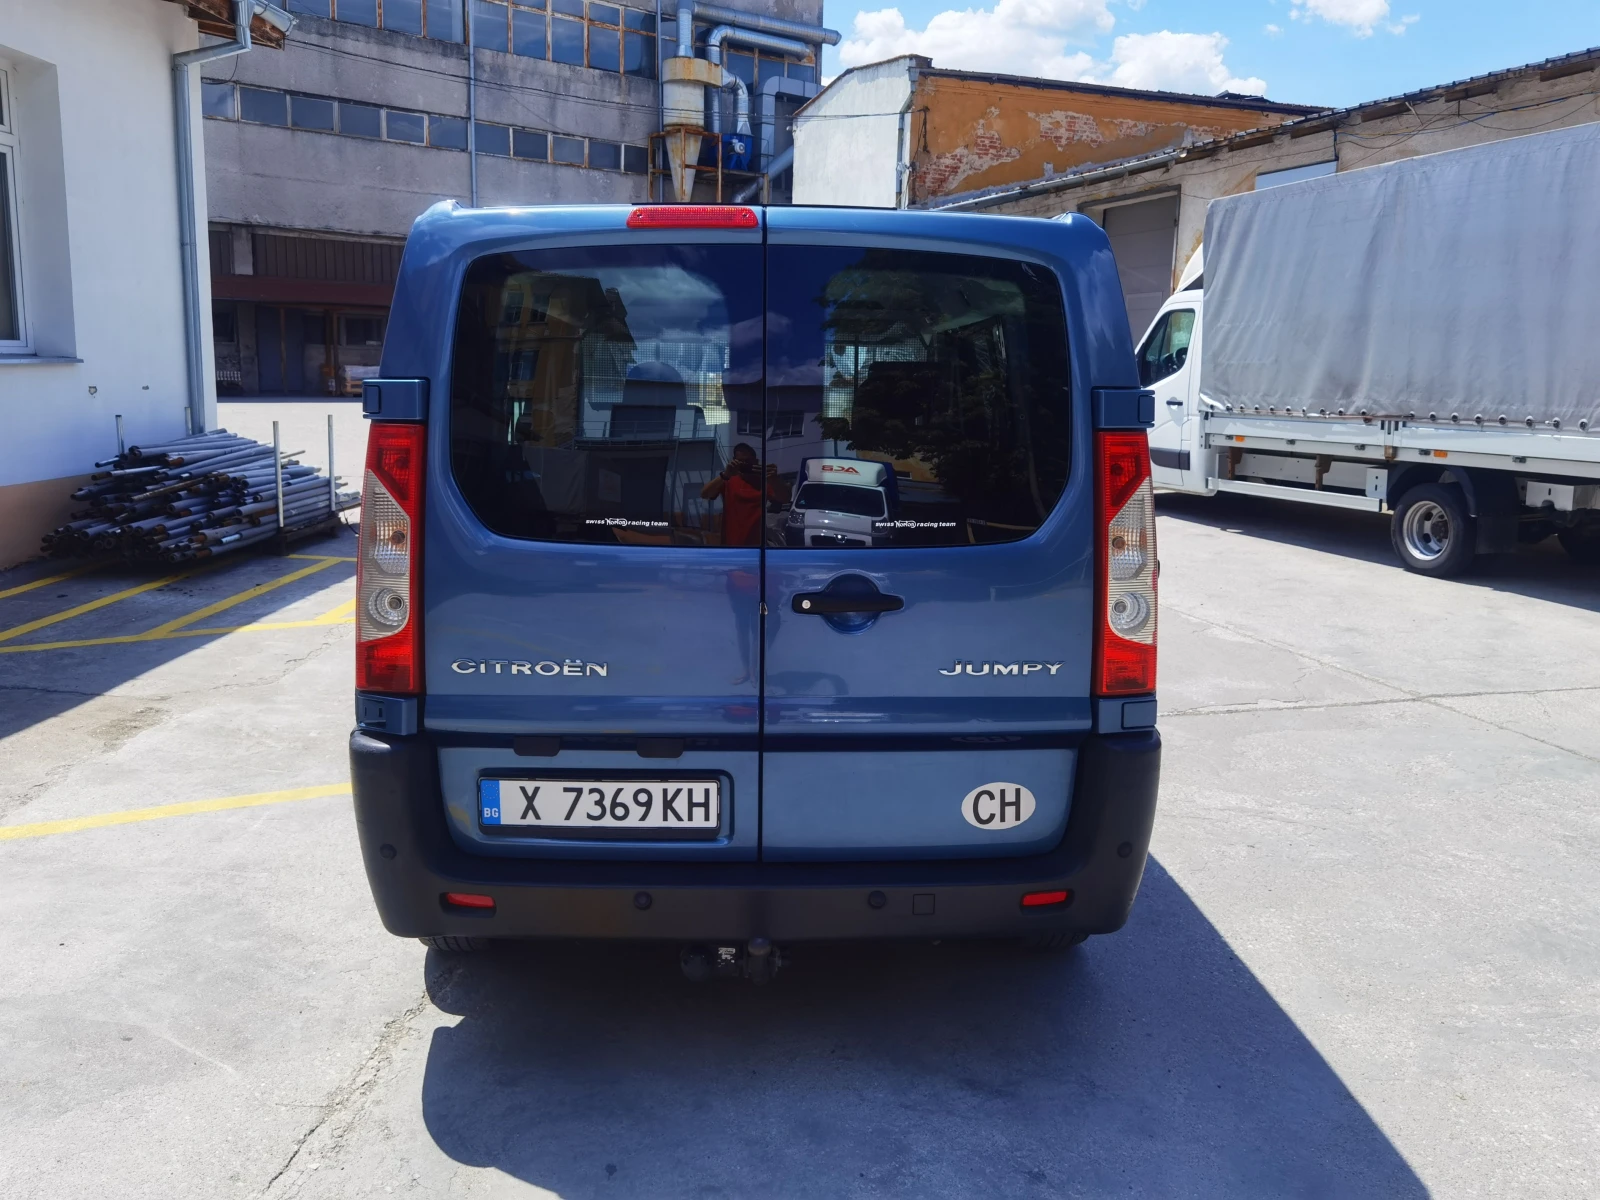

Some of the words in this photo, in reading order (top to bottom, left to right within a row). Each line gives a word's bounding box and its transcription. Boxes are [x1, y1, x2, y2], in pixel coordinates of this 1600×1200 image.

[605, 517, 628, 527] Norton
[628, 519, 650, 527] racing
[894, 520, 917, 529] Norton
[938, 659, 1066, 676] JUMPY
[519, 785, 542, 821] X
[972, 787, 1021, 826] CH
[483, 807, 499, 818] BG
